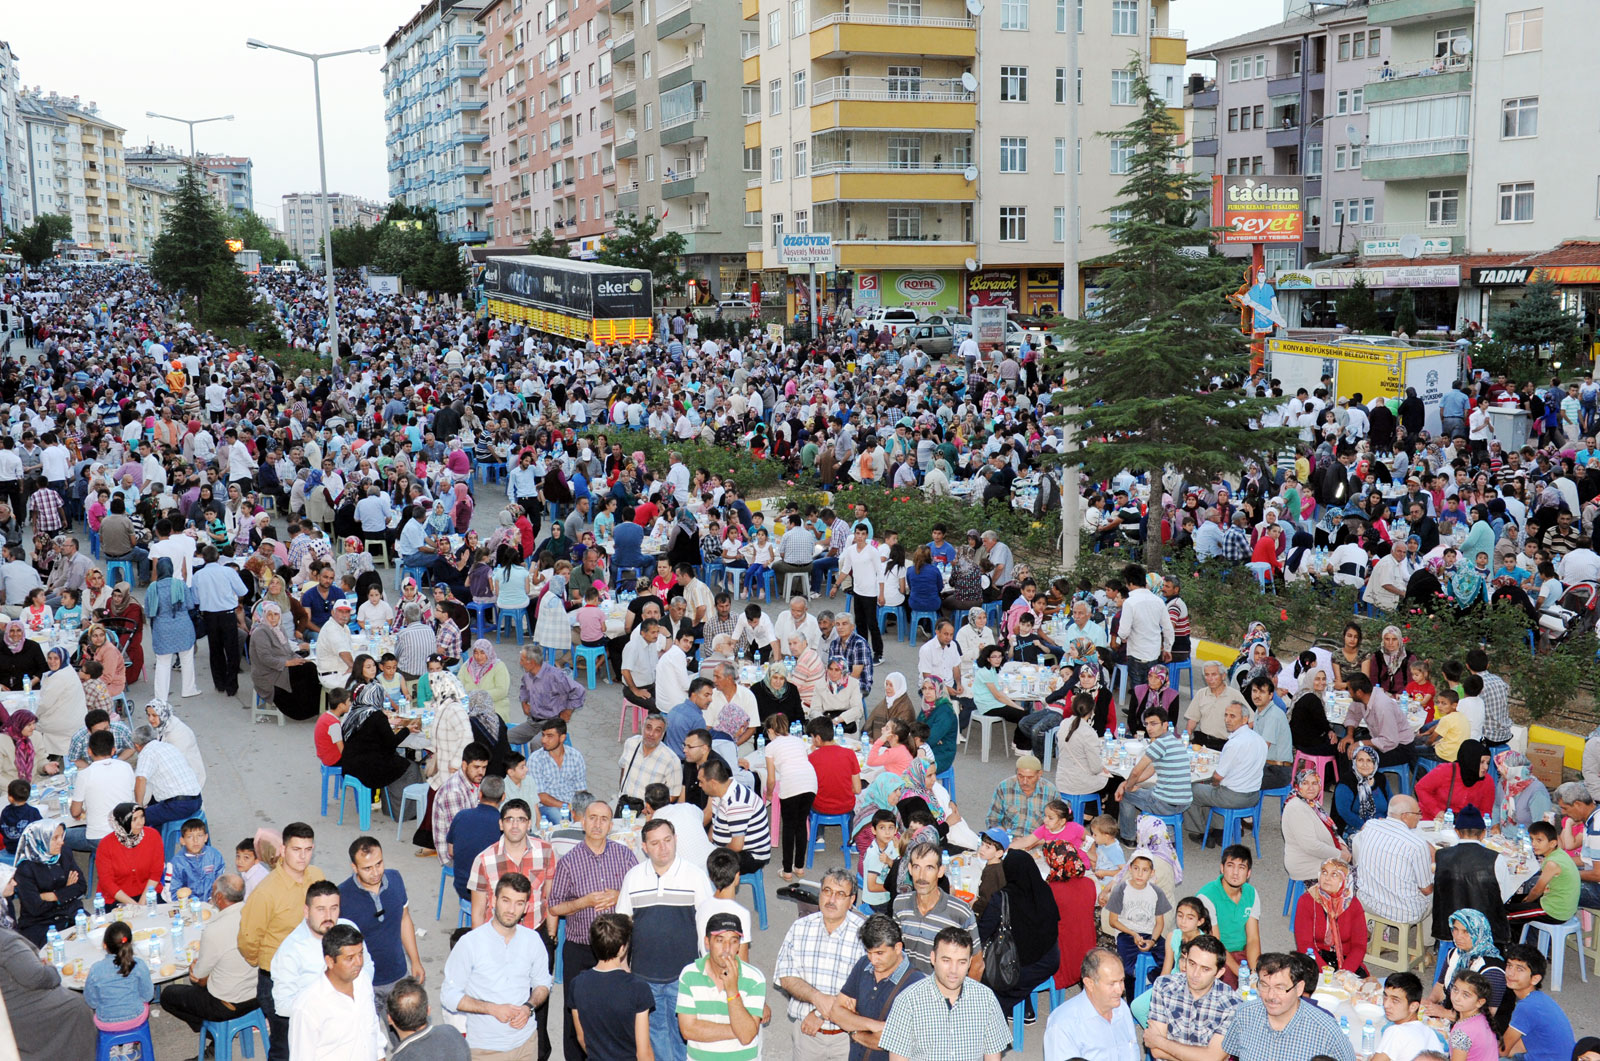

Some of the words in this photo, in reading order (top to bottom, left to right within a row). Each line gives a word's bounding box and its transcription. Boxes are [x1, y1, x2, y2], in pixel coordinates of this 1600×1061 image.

[783, 235, 830, 246] ÖZGÜVEN
[969, 275, 1017, 290] Baranok
[1479, 269, 1527, 283] TADIM
[598, 281, 630, 293] eker
[904, 281, 936, 290] ROYAL
[1283, 344, 1304, 352] KONYA
[1305, 346, 1343, 356] BÜYÜKŞEHİR
[1344, 350, 1380, 359] BELEDİYESİ
